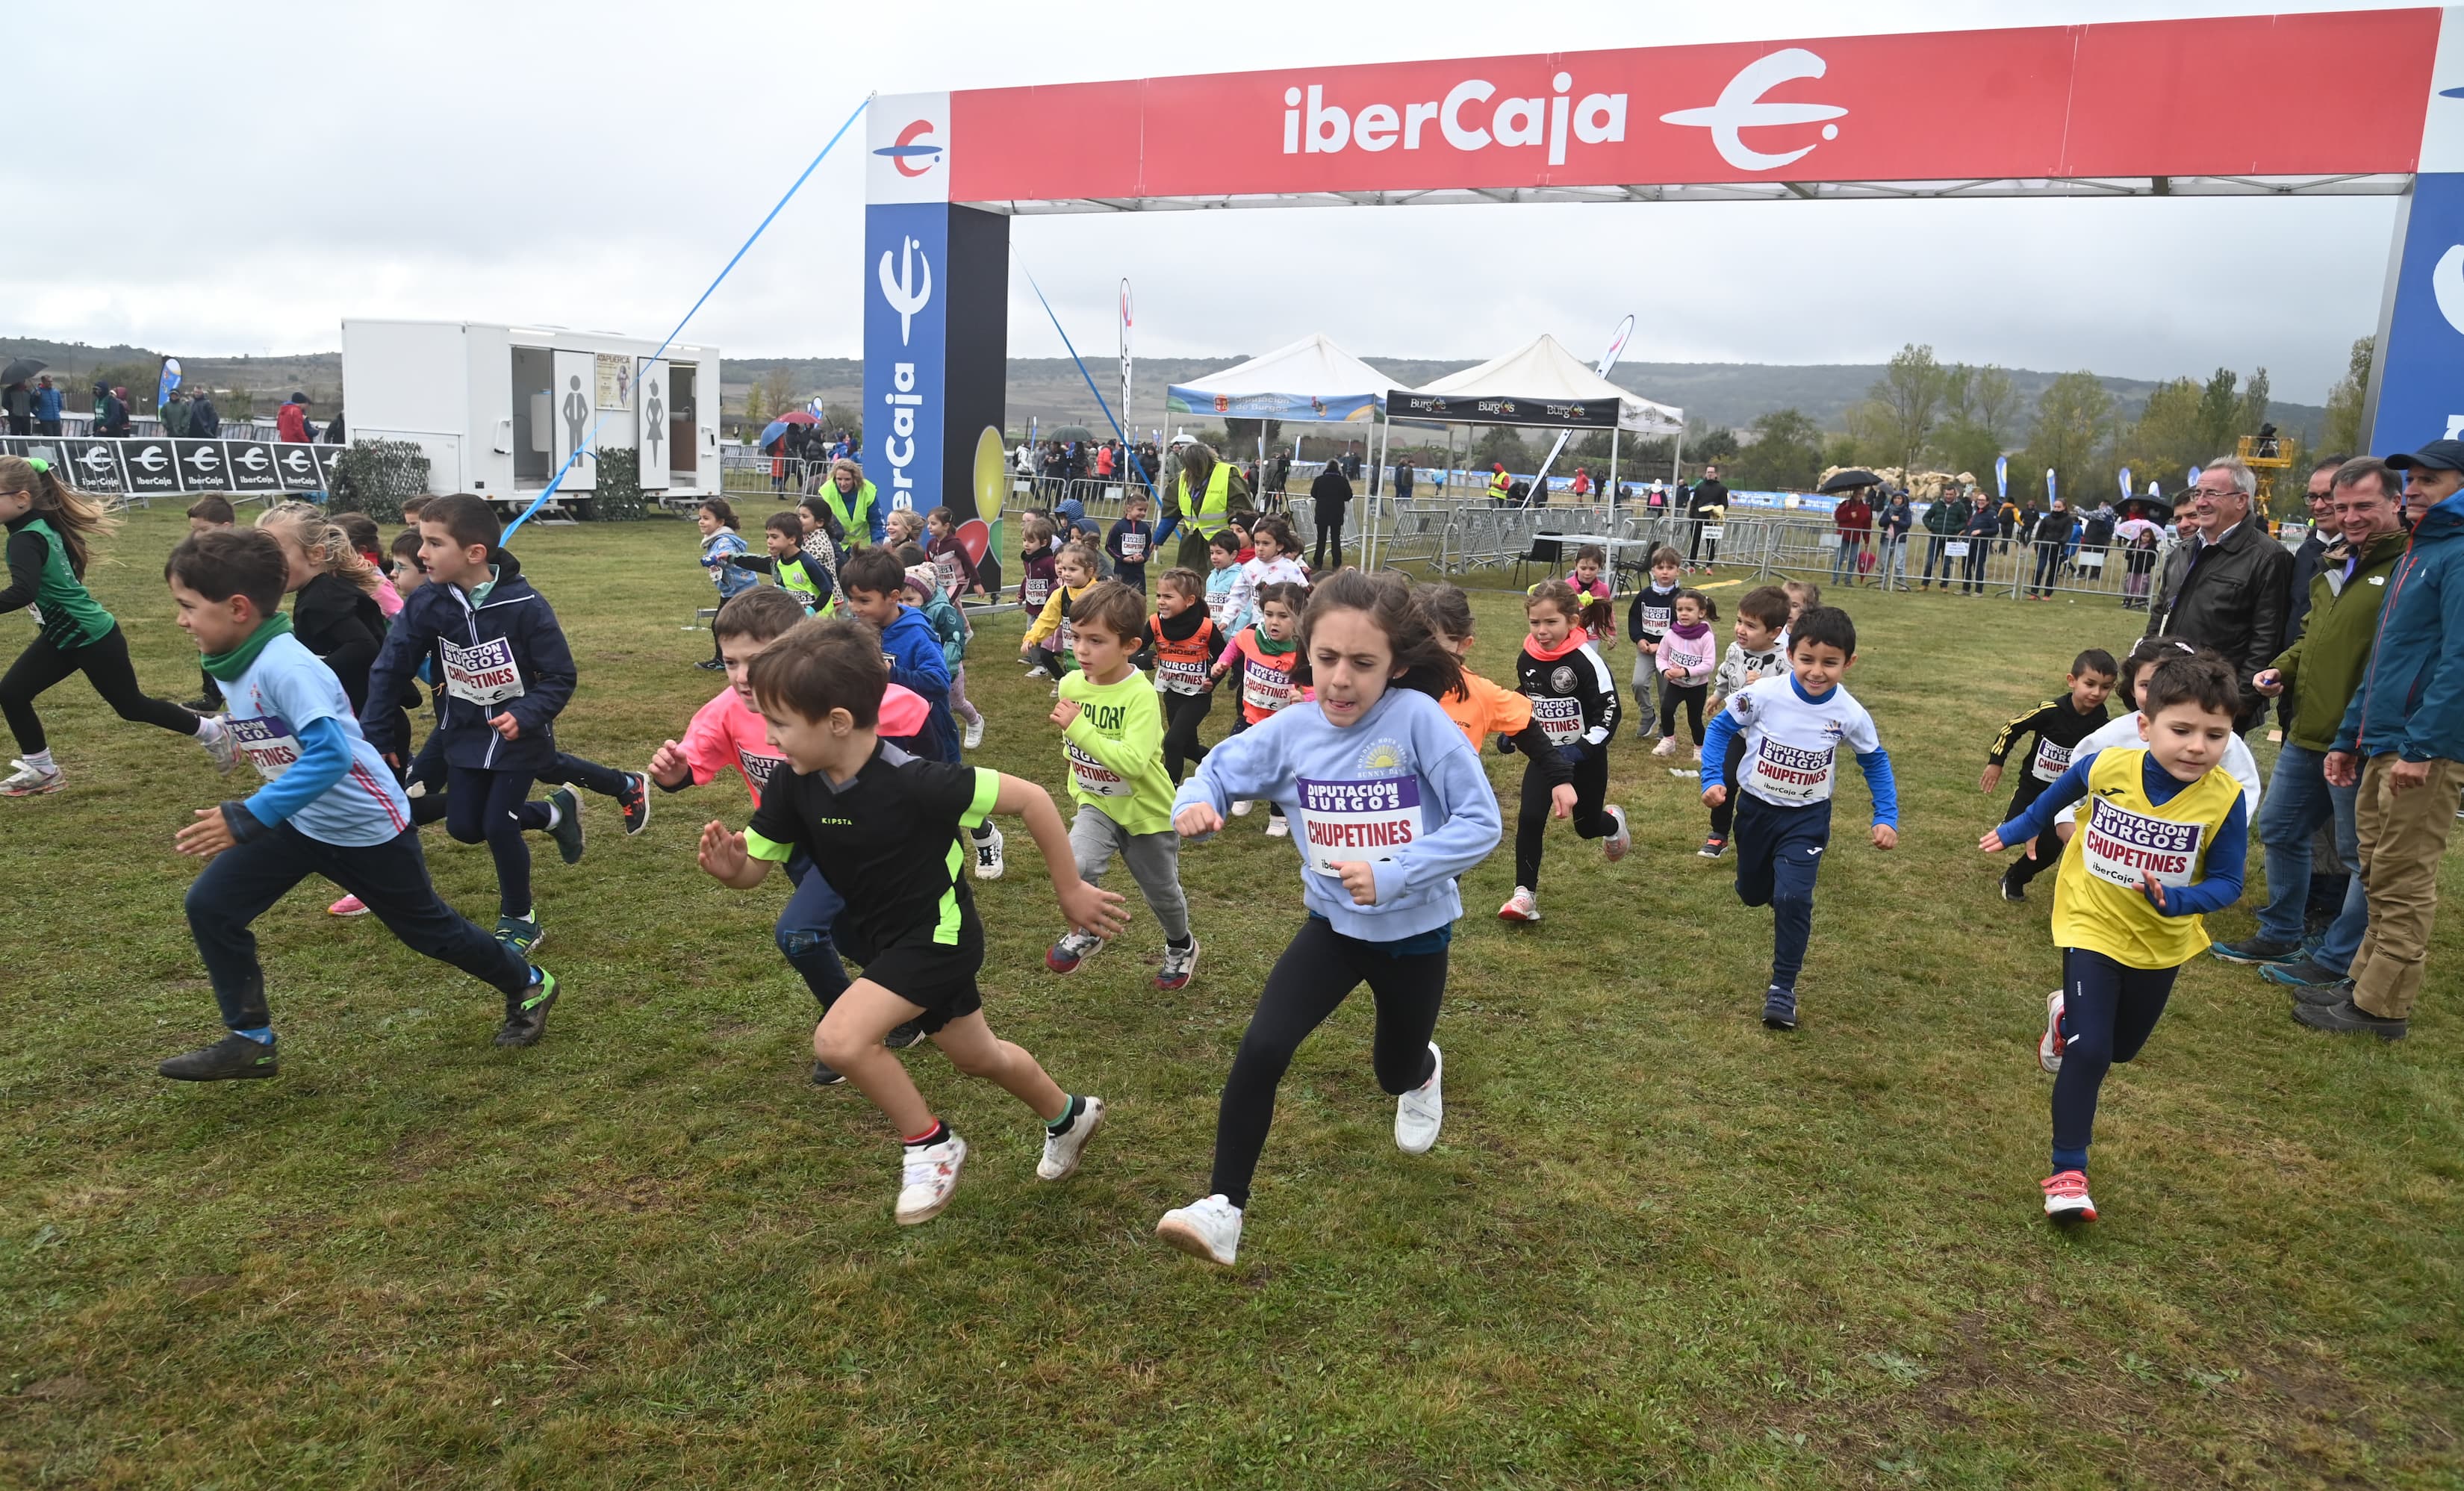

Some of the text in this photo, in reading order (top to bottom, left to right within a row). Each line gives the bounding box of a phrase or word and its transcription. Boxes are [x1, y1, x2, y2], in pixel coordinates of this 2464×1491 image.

[1283, 72, 1628, 166] iberCaja
[886, 363, 923, 511] erCaja
[137, 477, 172, 486] iberCaja
[188, 476, 224, 486] iberCaja
[240, 475, 275, 485] iberCaja
[287, 476, 317, 486] iberCaja
[443, 641, 502, 660] DIPUACIÓN
[1158, 669, 1203, 685] CHUPETINES
[1250, 668, 1289, 684] BURGOS
[1245, 676, 1289, 699] CHUPETINES
[1537, 707, 1575, 718] RGOS
[226, 720, 267, 732] TACIÓN
[1540, 718, 1580, 732] PETINES
[2045, 741, 2073, 756] DIPUTA
[1763, 748, 1829, 770] BURGOS
[2038, 757, 2070, 773] CHUPE
[1072, 760, 1121, 782] PETINES
[1757, 760, 1827, 786] CHUPETINES
[1307, 781, 1399, 798] DIPUTACIÓN
[1764, 782, 1796, 796] iberCaja
[1307, 794, 1400, 811] BURGOS
[2098, 801, 2191, 838] DIPUTACIÓN
[1307, 819, 1413, 847] CHUPETINES
[2093, 812, 2188, 851] BURGOS
[2087, 830, 2187, 874] CHUPETINES
[2093, 862, 2134, 884] iberCaja
